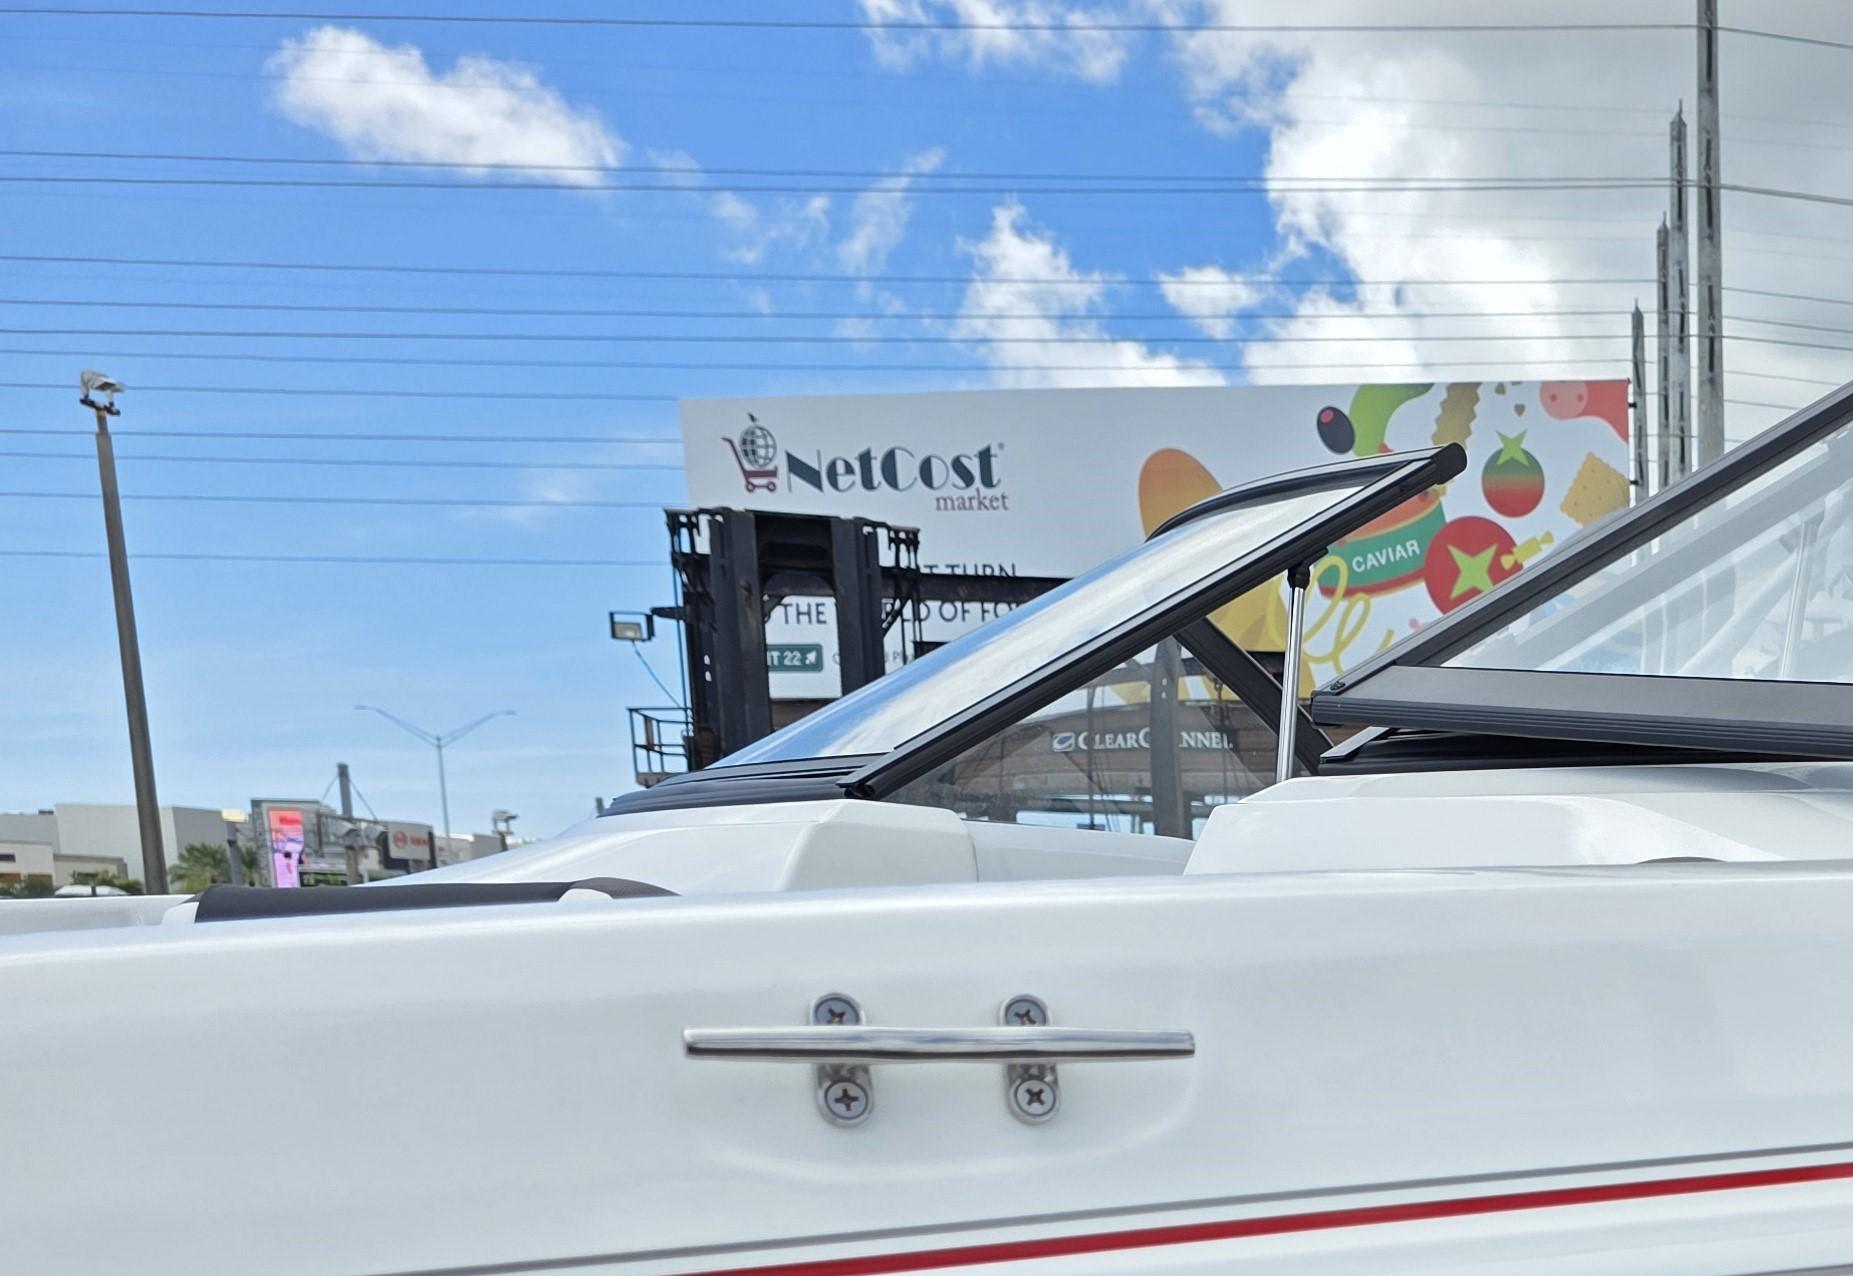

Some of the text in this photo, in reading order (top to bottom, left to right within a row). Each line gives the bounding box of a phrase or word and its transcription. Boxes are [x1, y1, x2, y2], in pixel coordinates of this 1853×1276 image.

[784, 443, 1001, 493] NetCost
[935, 487, 1009, 512] market
[1351, 539, 1420, 573] CAVIAR
[781, 602, 827, 625] THE
[939, 600, 970, 622] OF
[783, 650, 802, 666] 22
